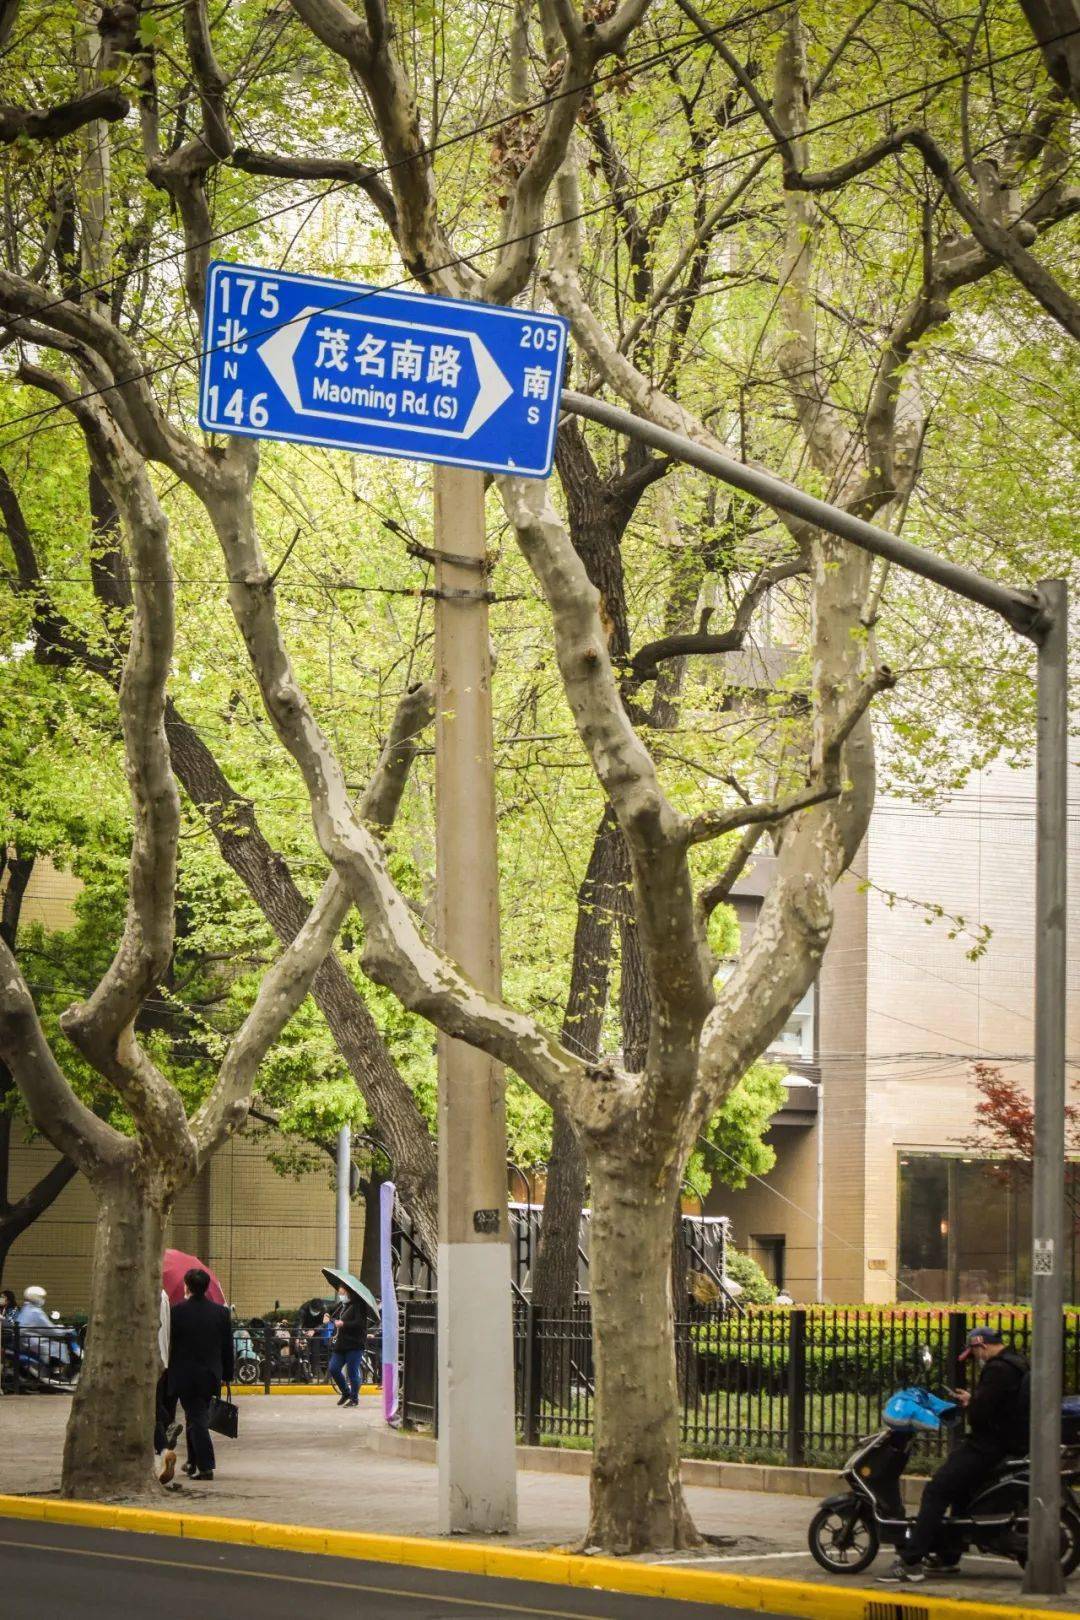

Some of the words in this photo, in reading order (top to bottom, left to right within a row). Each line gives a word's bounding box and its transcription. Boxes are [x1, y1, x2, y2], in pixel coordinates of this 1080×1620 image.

[219, 276, 280, 319] 175
[217, 318, 248, 355] 北
[520, 325, 557, 352] 205
[224, 361, 238, 380] N
[315, 326, 463, 389] 茂名南路
[312, 376, 397, 417] Maoming
[401, 393, 430, 416] Rd.
[433, 395, 459, 420] (S)
[522, 366, 552, 401] 南
[208, 384, 270, 428] 146
[527, 405, 541, 424] S
